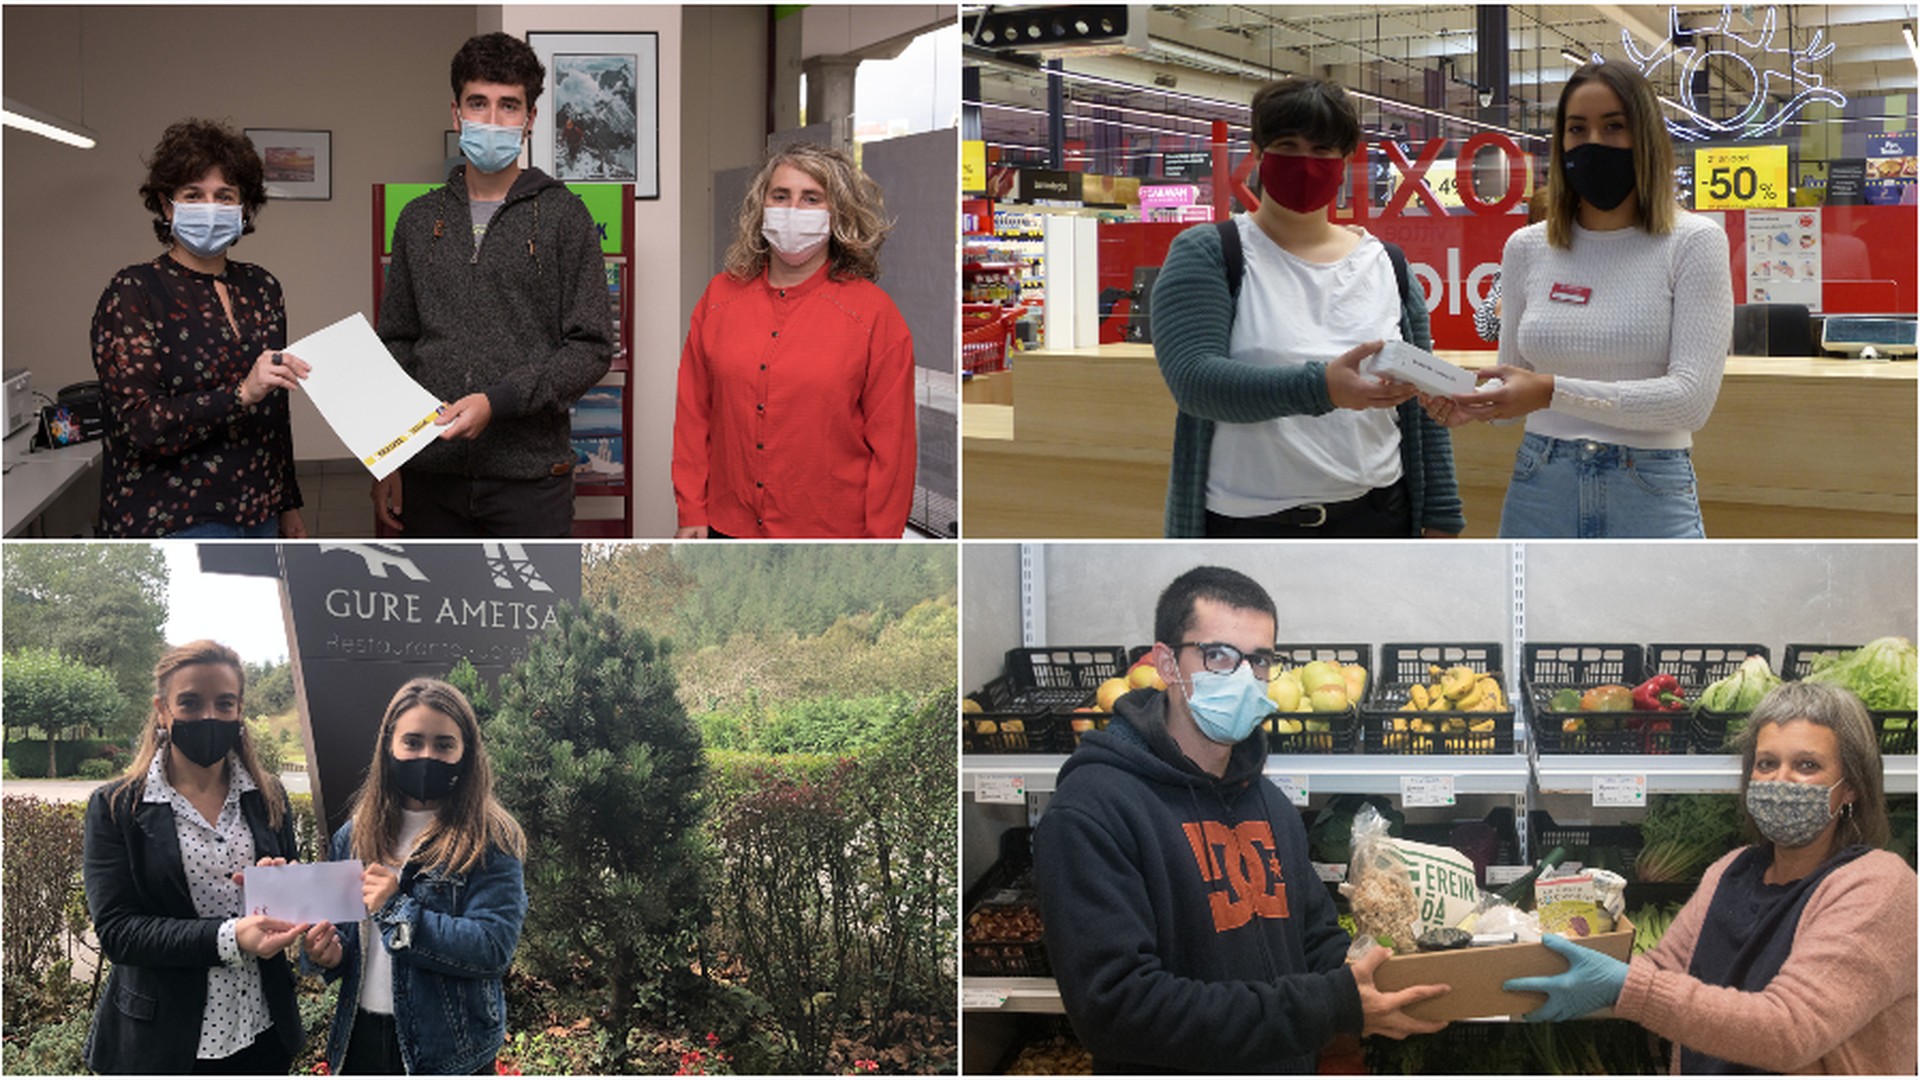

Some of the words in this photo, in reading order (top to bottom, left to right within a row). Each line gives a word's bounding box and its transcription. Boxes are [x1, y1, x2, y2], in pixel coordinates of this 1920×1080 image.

[1211, 119, 1527, 222] kixo
[326, 588, 421, 624] GURE
[434, 596, 558, 630] AMETSA
[1425, 863, 1475, 903] EREIN
